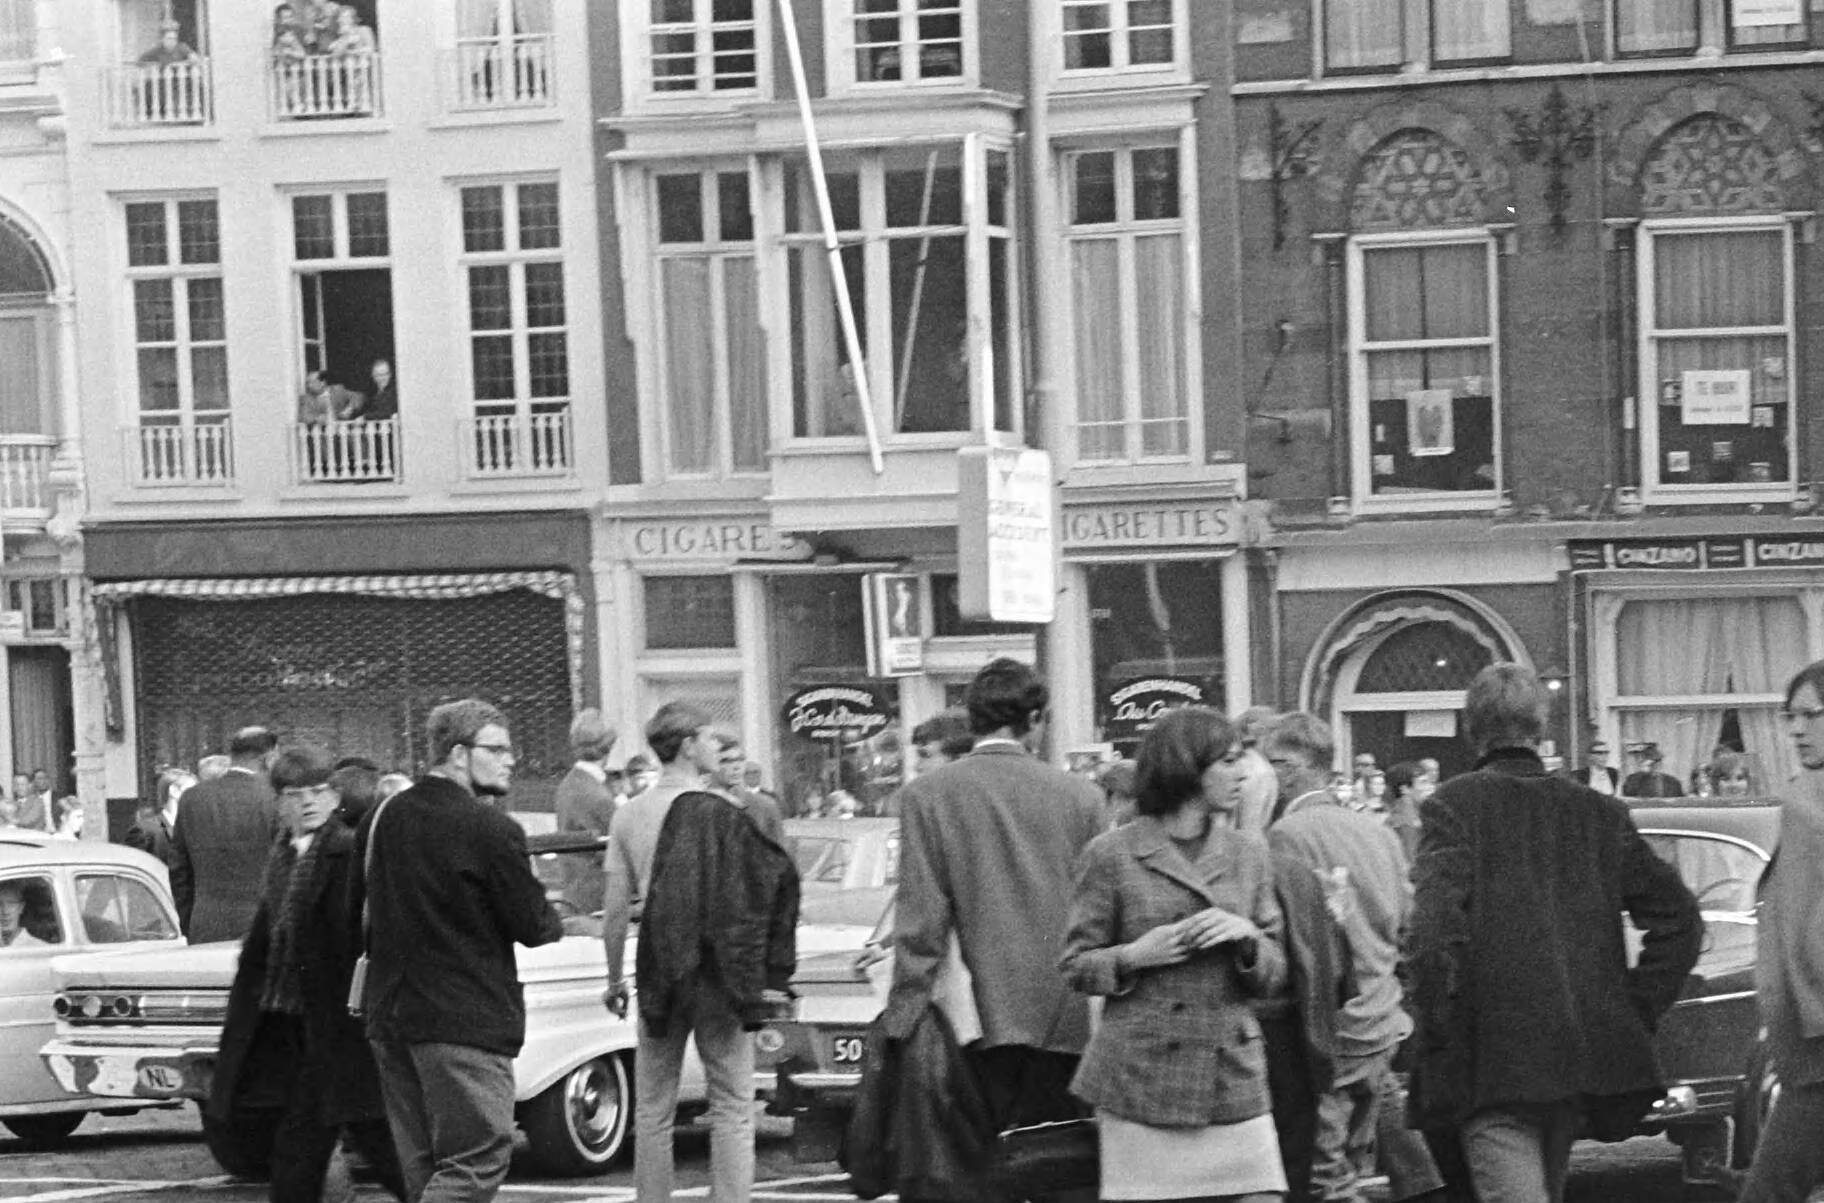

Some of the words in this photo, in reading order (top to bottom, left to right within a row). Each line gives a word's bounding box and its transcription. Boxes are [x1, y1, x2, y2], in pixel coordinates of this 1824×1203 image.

[1061, 508, 1229, 541] IGARETTES
[1616, 546, 1698, 564] CINZANO
[833, 1038, 863, 1061] 50
[146, 1068, 175, 1089] NL
